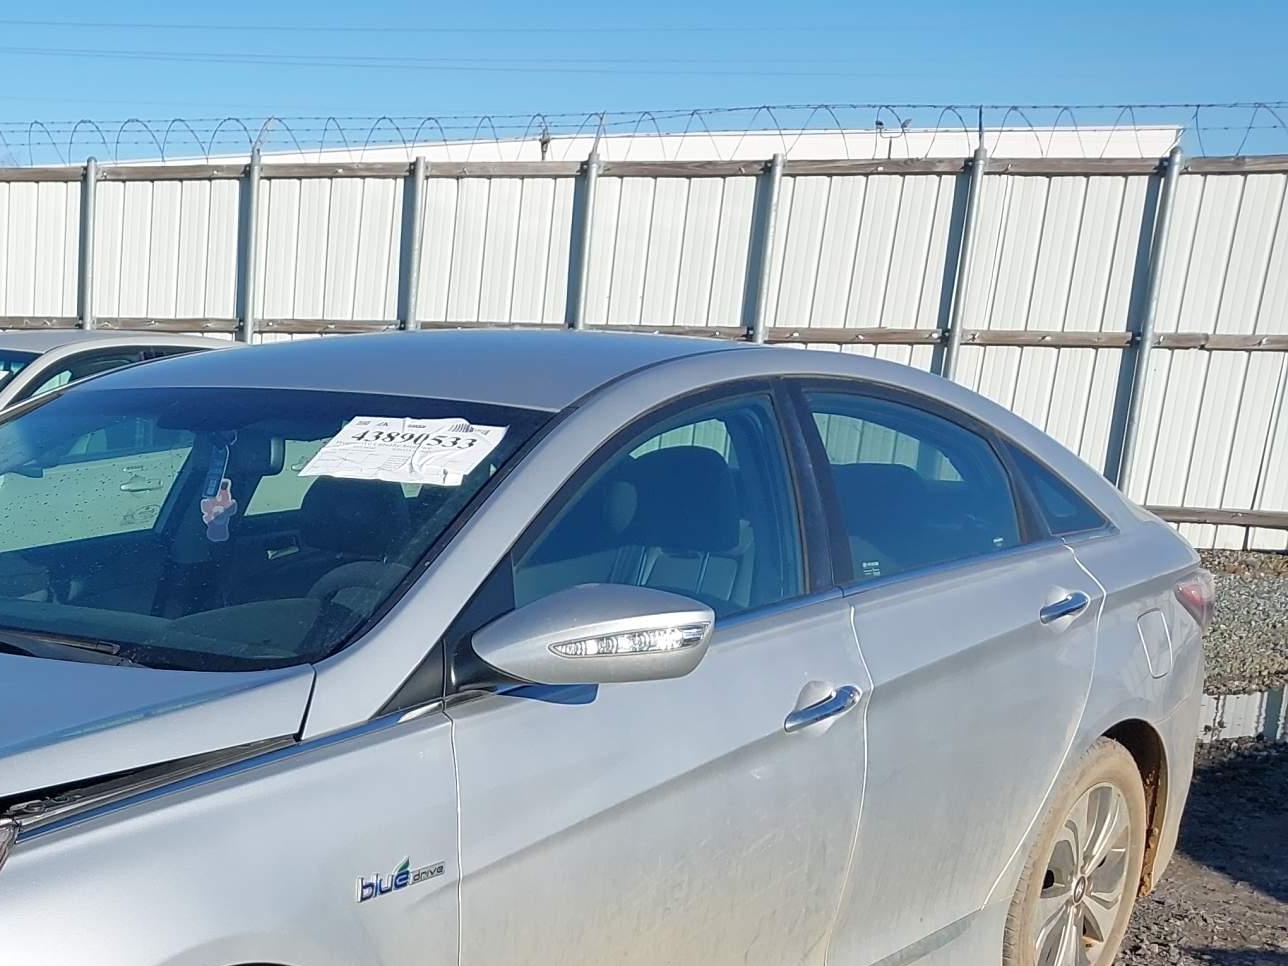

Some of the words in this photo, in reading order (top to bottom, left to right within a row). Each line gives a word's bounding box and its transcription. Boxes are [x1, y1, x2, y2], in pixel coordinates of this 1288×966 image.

[351, 430, 478, 449] 43890533
[357, 867, 409, 903] blue
[413, 864, 444, 882] drive
